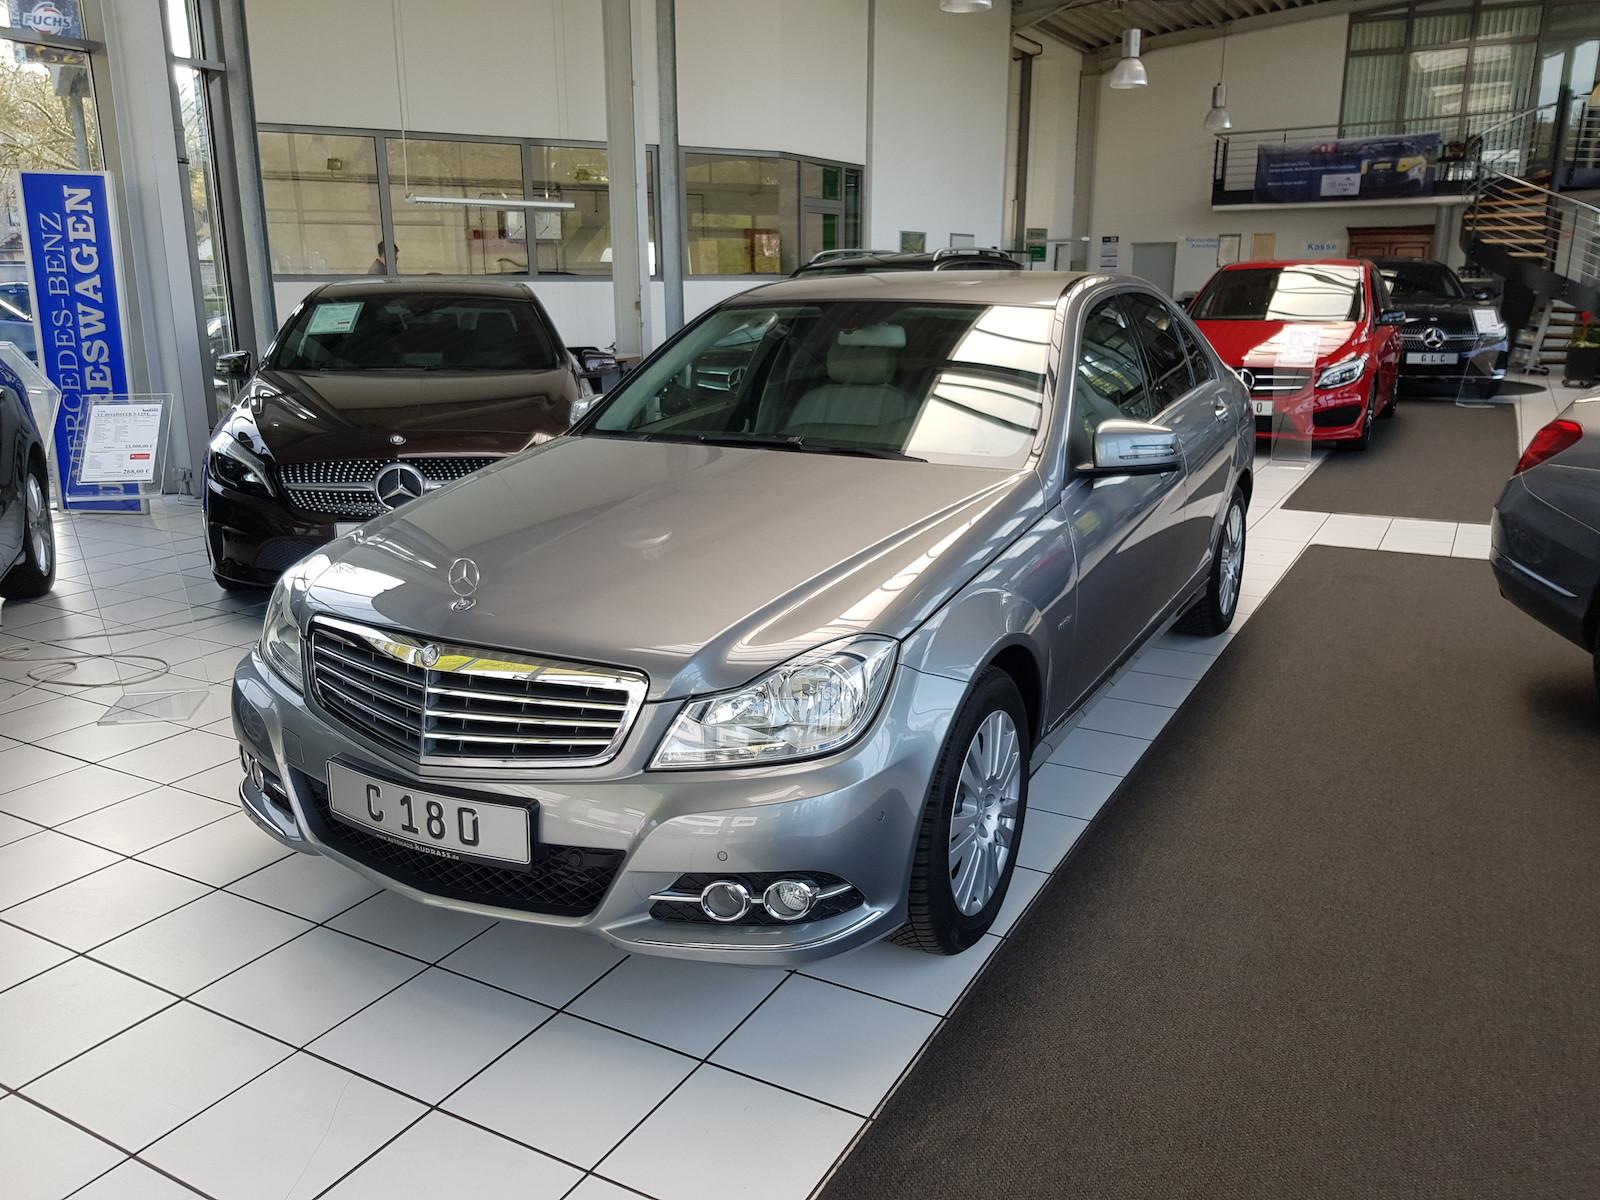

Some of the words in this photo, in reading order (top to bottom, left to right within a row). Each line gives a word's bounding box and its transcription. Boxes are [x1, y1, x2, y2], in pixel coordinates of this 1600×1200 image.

[24, 14, 71, 28] FUCHS
[63, 185, 125, 498] JESWAGEN
[366, 783, 384, 822] C
[400, 794, 480, 847] 180
